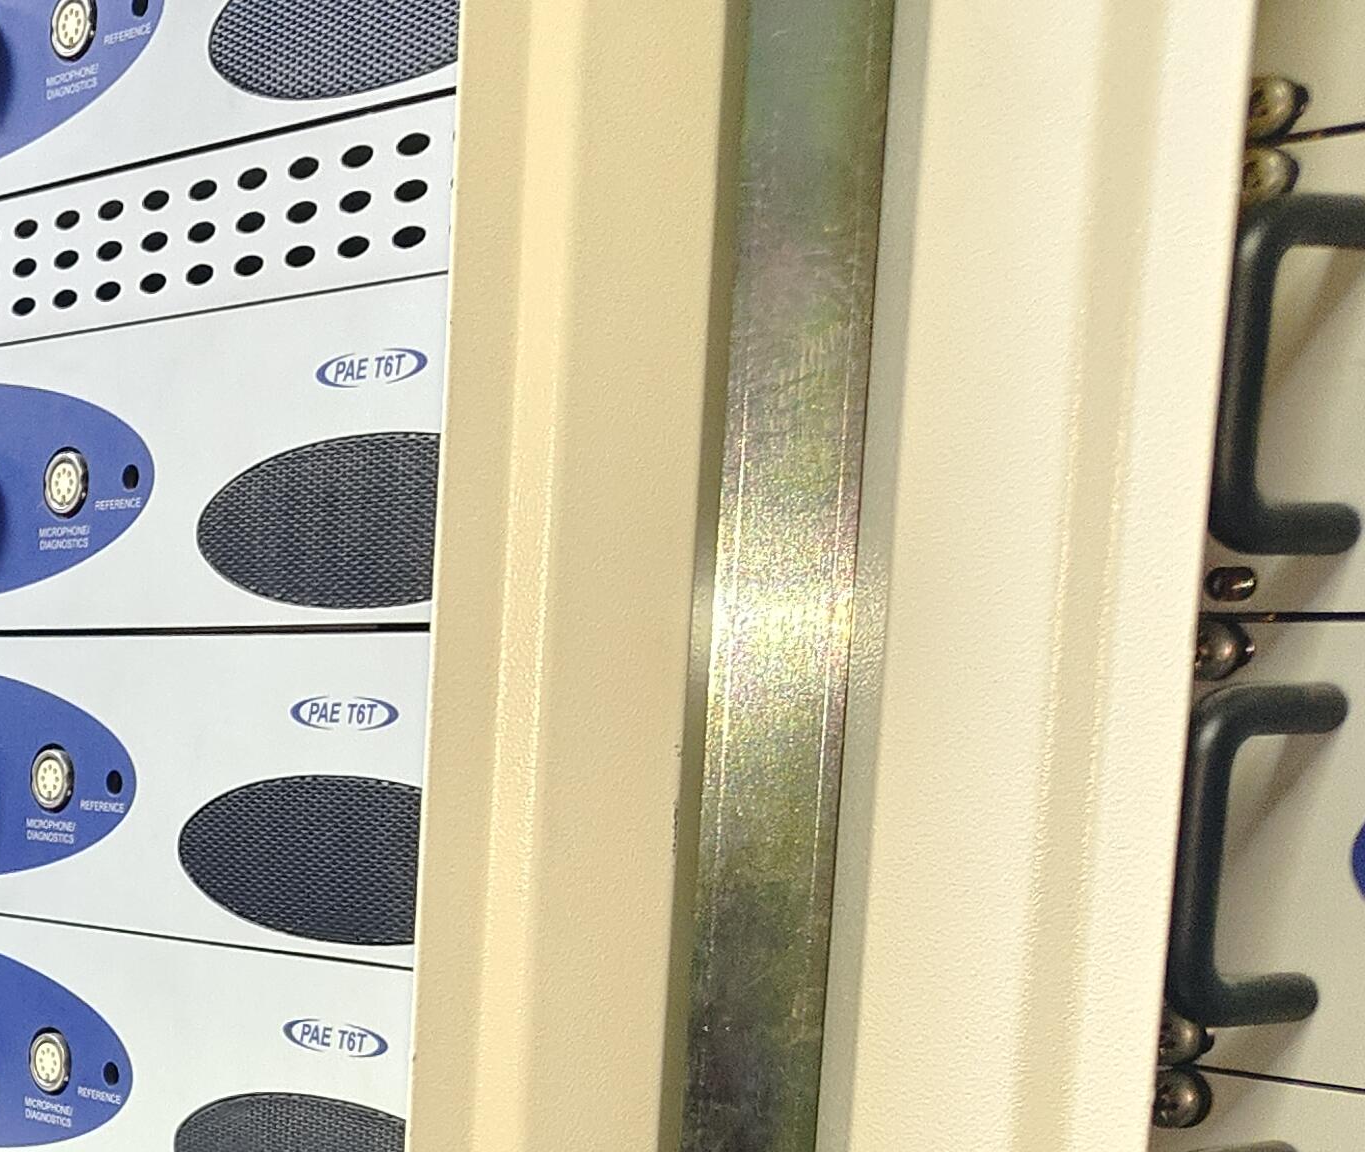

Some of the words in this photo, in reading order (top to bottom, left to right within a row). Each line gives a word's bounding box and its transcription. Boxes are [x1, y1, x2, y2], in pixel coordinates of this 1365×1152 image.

[103, 22, 152, 45] REFERENCE
[47, 77, 97, 100] DIAGNOSTICS
[334, 358, 368, 383] PAE
[374, 353, 406, 378] T6T
[95, 500, 141, 511] REFERENCE
[39, 538, 89, 551] DIAGNOSTICS
[308, 702, 341, 723] PAE
[347, 703, 378, 725] T6T
[80, 799, 125, 814] REFERENCE
[26, 831, 74, 845] DIAGNOSTICS
[300, 1023, 333, 1047] PAE
[338, 1030, 367, 1053] T6T
[77, 1086, 121, 1105] REFERENCE
[25, 1110, 72, 1128] DIAGNOSTICS
